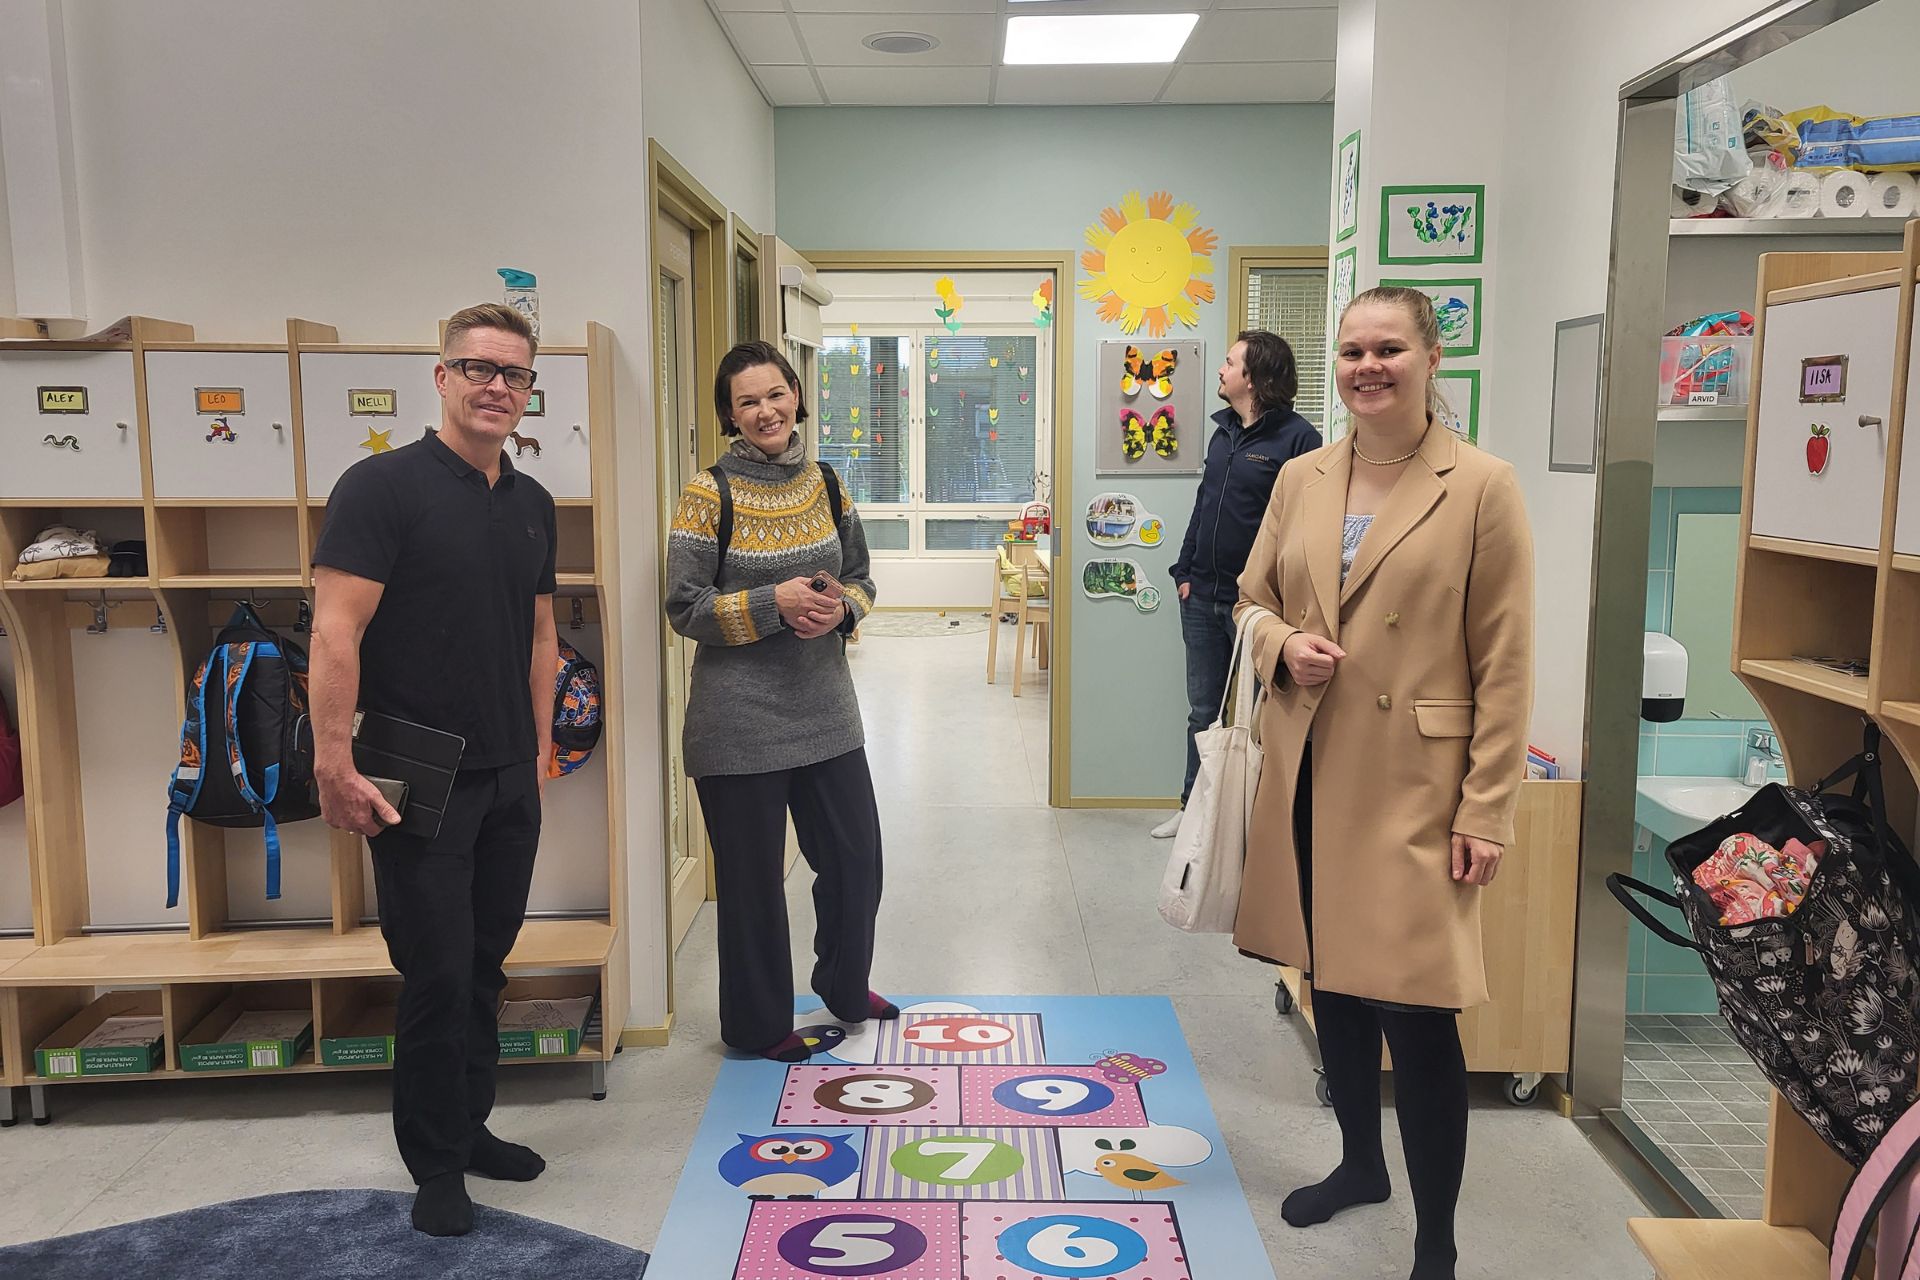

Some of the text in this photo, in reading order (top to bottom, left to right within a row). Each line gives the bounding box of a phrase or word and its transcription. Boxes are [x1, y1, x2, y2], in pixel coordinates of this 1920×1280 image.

[207, 393, 226, 404] LEO
[357, 397, 387, 407] NELLI
[904, 1025, 1010, 1044] 10
[839, 1079, 914, 1108] 8
[1016, 1079, 1090, 1110] 9
[918, 1142, 996, 1179] 7
[808, 1222, 896, 1266] 5
[1026, 1224, 1118, 1267] 6
